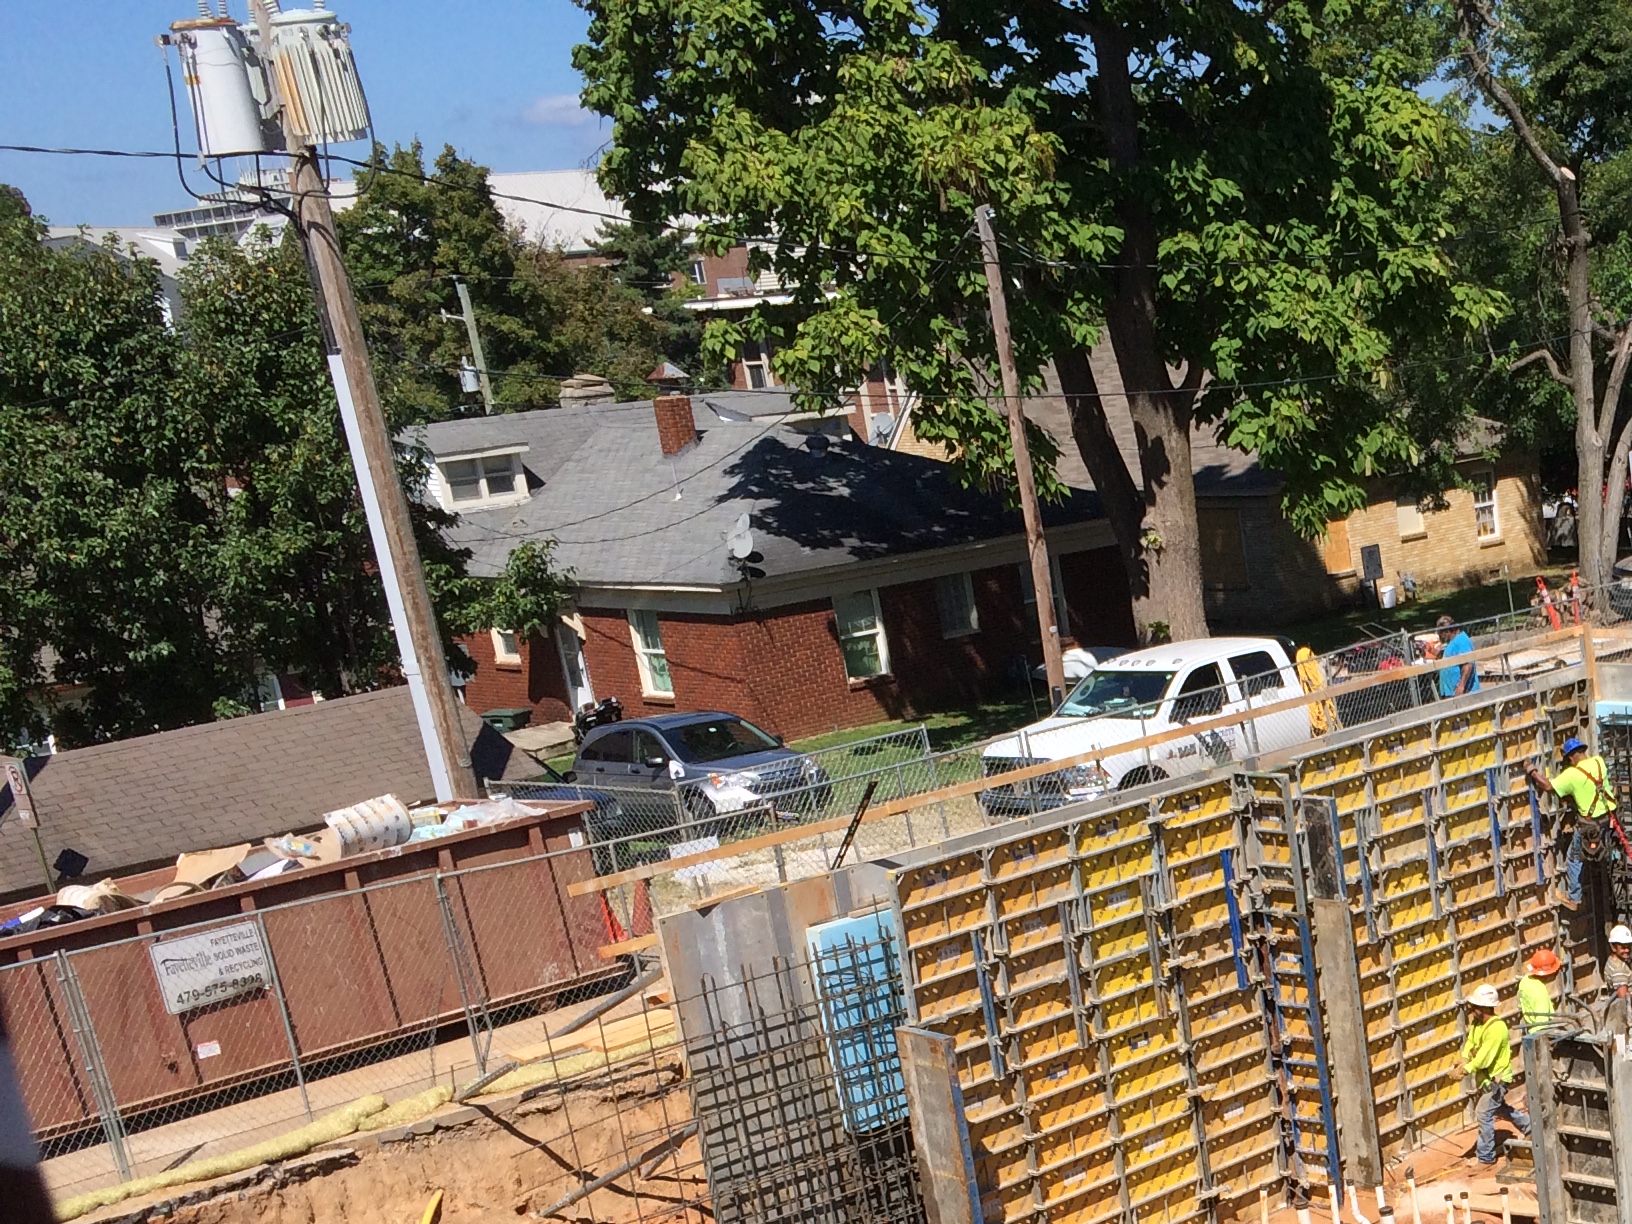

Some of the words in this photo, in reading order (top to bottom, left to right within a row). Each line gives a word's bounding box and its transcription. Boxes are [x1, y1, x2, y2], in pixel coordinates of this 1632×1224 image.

[210, 929, 254, 946] FAYETTEVILLE
[213, 948, 235, 962] SOLID
[235, 942, 260, 956] WASTE
[161, 950, 213, 976] Fayetteville
[224, 957, 264, 975] RECYCLING
